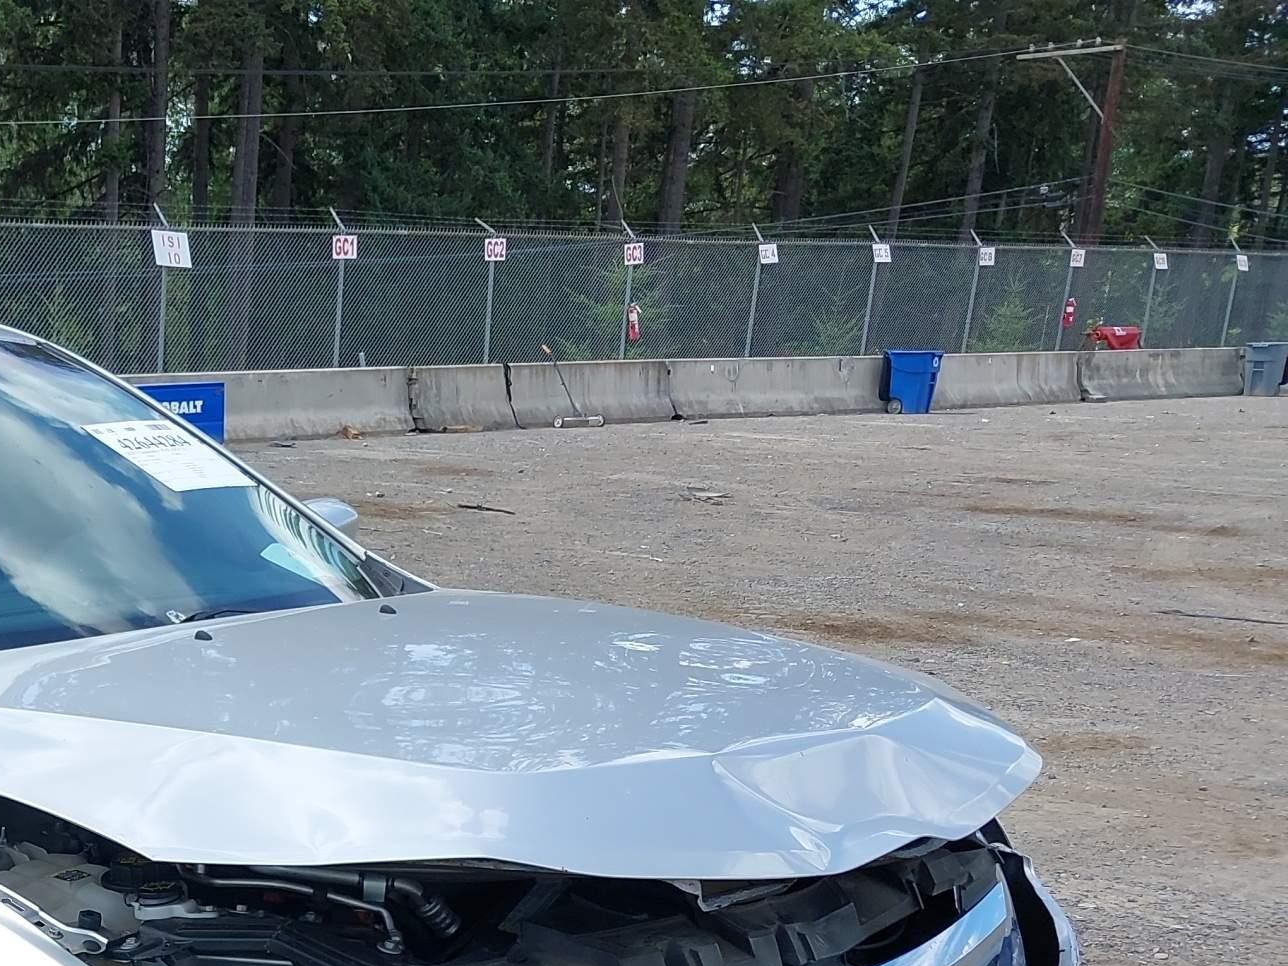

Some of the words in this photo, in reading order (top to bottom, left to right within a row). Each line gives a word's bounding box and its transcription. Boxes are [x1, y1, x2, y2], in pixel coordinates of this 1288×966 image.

[335, 237, 354, 256] GC1
[486, 240, 504, 258] GC2
[626, 245, 642, 262] GC3
[117, 435, 192, 450] 42644284
